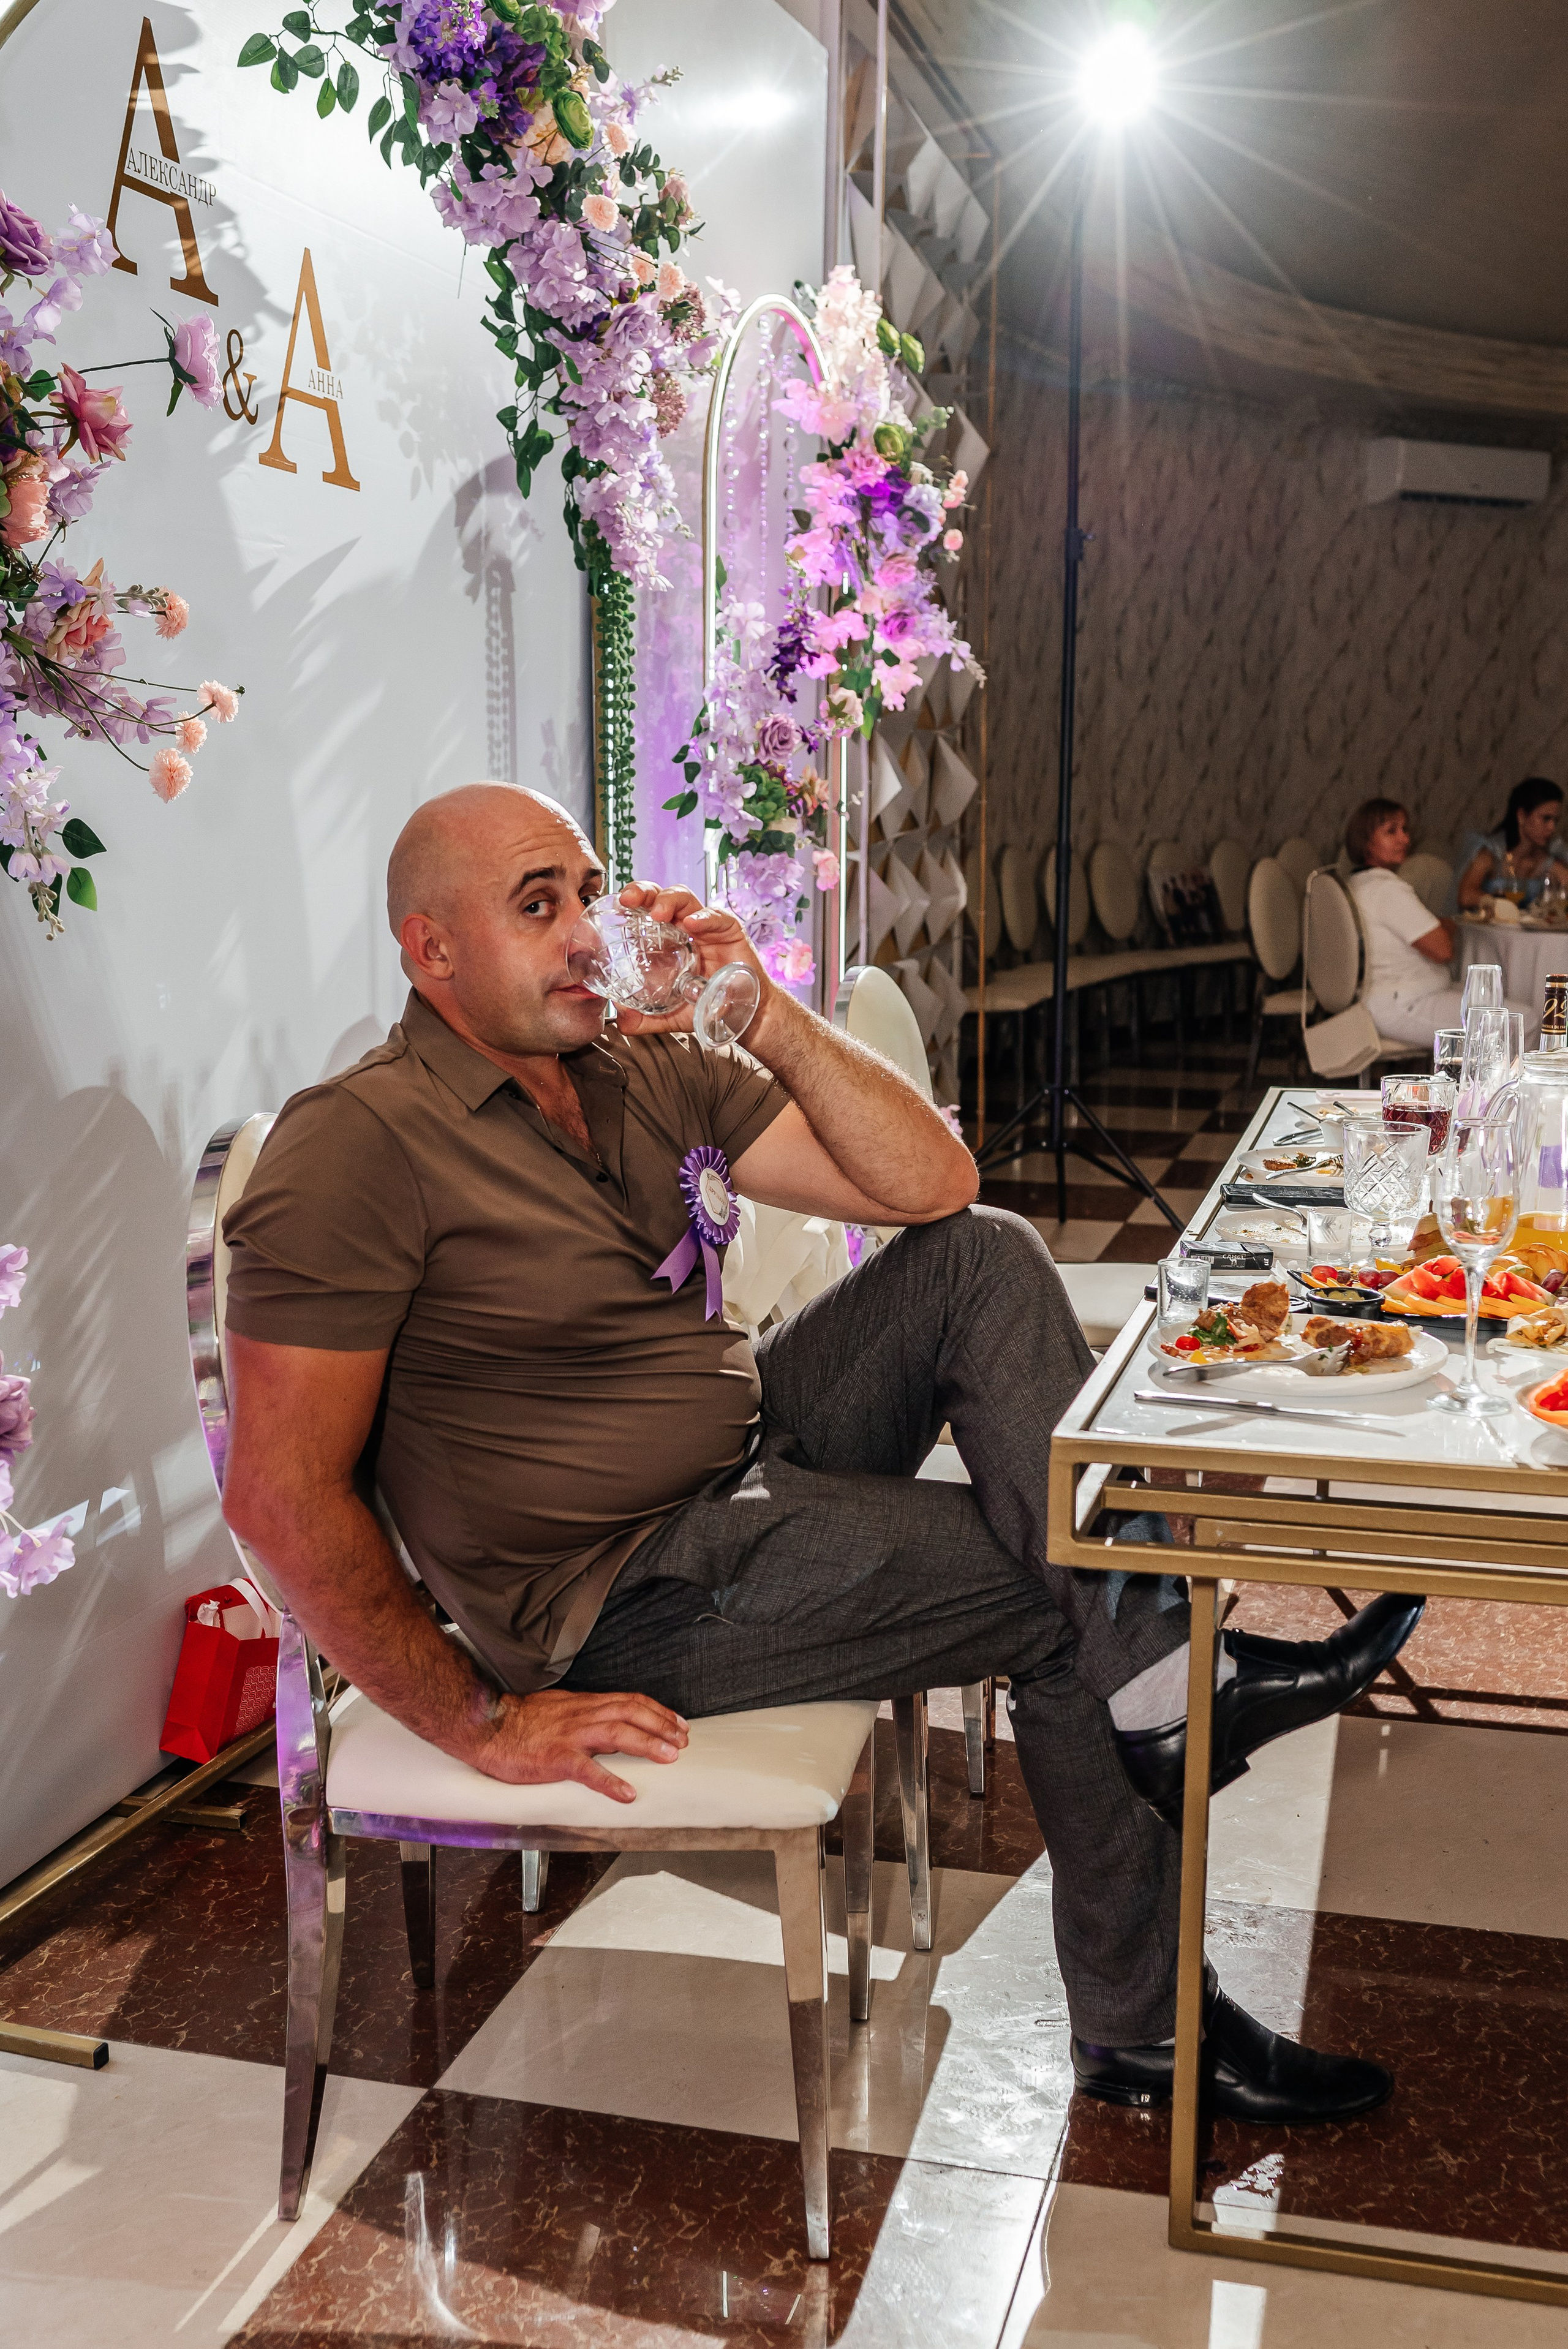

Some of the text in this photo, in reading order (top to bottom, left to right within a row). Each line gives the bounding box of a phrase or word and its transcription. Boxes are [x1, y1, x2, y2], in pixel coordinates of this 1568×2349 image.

[126, 147, 217, 209] АЛЕКСАНДР
[222, 329, 258, 425] &
[308, 369, 344, 399] АННА
